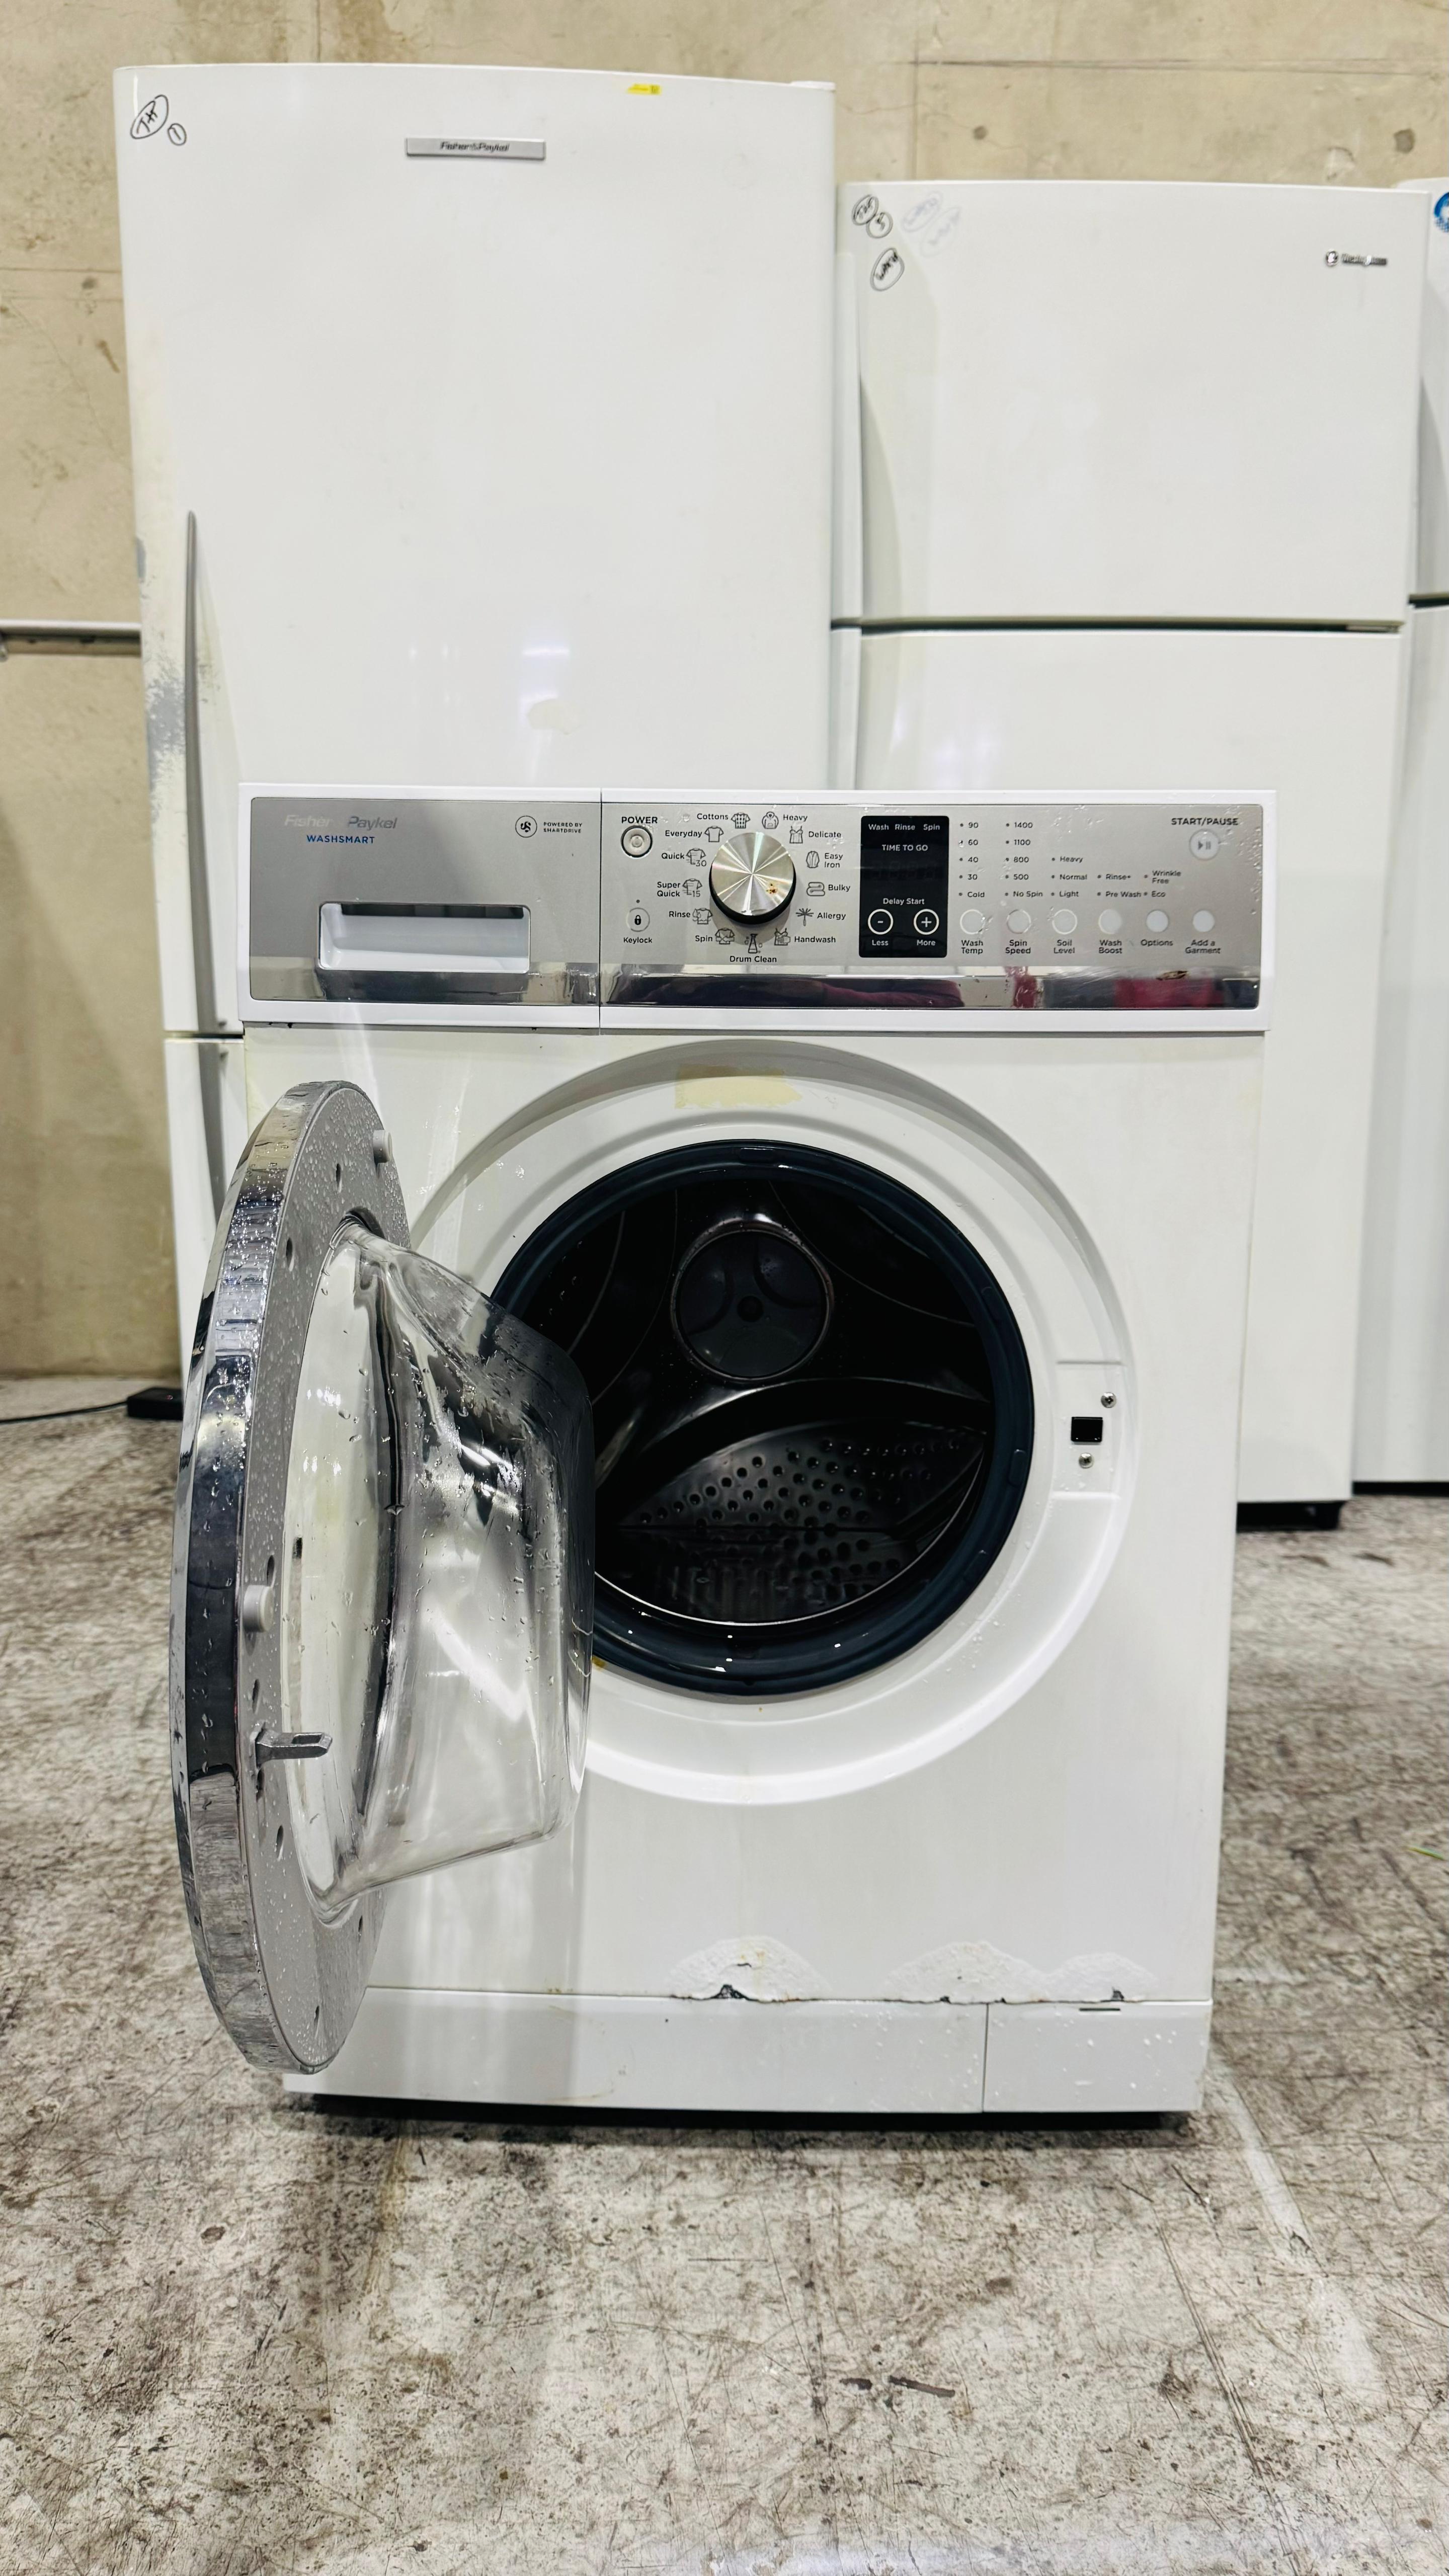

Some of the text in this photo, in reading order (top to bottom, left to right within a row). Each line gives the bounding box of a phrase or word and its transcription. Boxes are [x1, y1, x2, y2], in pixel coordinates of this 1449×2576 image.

[284, 814, 397, 830] Fisher Paykel
[621, 816, 658, 824] POWER
[783, 814, 808, 822] Heavy
[1171, 817, 1239, 826] START/PAUSE
[665, 830, 702, 838] Everyday
[306, 834, 375, 844] WASHSMART
[824, 852, 843, 861] Easy
[657, 881, 681, 889] Super
[828, 884, 851, 893] Bulky
[882, 898, 905, 906] Delay
[817, 912, 846, 921] Allergy
[623, 936, 653, 944] Keylock
[695, 935, 713, 943] Spin
[1009, 939, 1027, 947] Spin
[1140, 939, 1173, 947] Options
[961, 947, 983, 955] Temp
[1005, 947, 1031, 955] Speed
